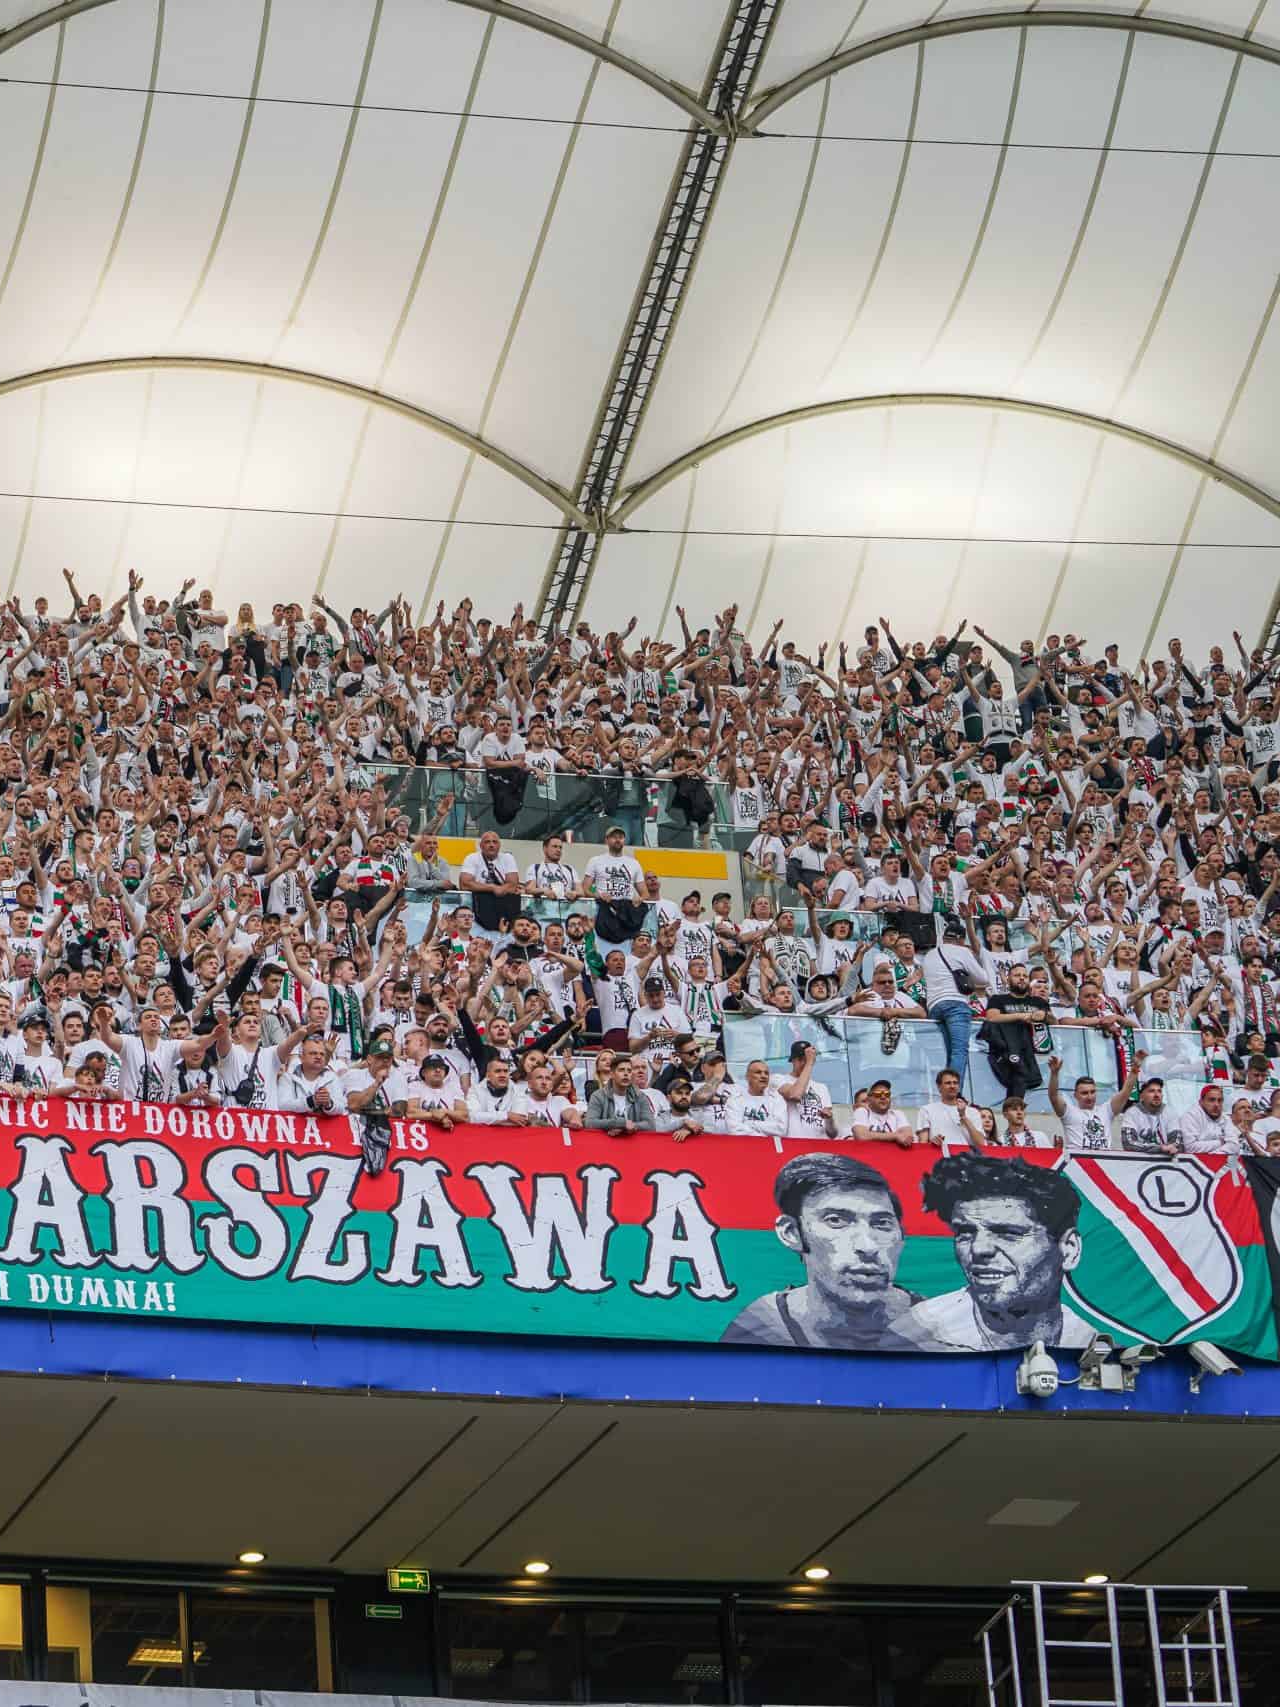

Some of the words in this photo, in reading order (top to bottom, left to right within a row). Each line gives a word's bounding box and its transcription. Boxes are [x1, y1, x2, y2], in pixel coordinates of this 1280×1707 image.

[65, 1100, 127, 1133] NIE
[144, 1104, 332, 1148] DORÓWNA,
[1155, 1175, 1186, 1208] L
[27, 1272, 177, 1312] DUMNA!
